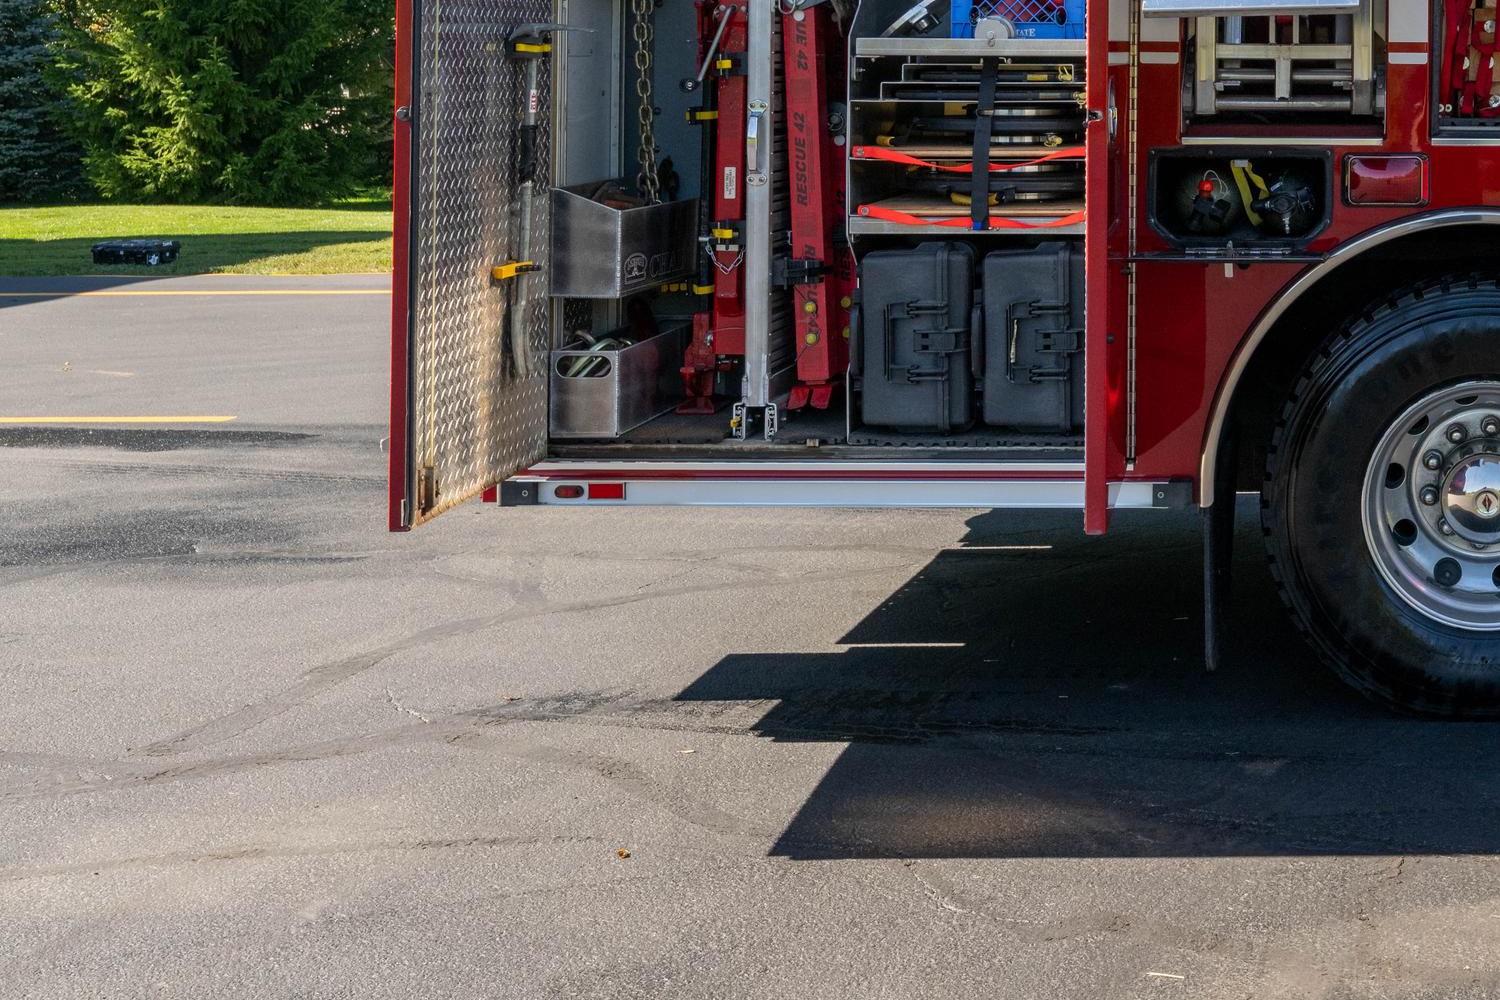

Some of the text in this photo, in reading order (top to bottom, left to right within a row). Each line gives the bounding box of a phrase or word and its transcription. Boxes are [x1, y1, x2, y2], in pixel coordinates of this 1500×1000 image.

[1015, 27, 1036, 37] TATE
[793, 111, 810, 207] RESCUE 42
